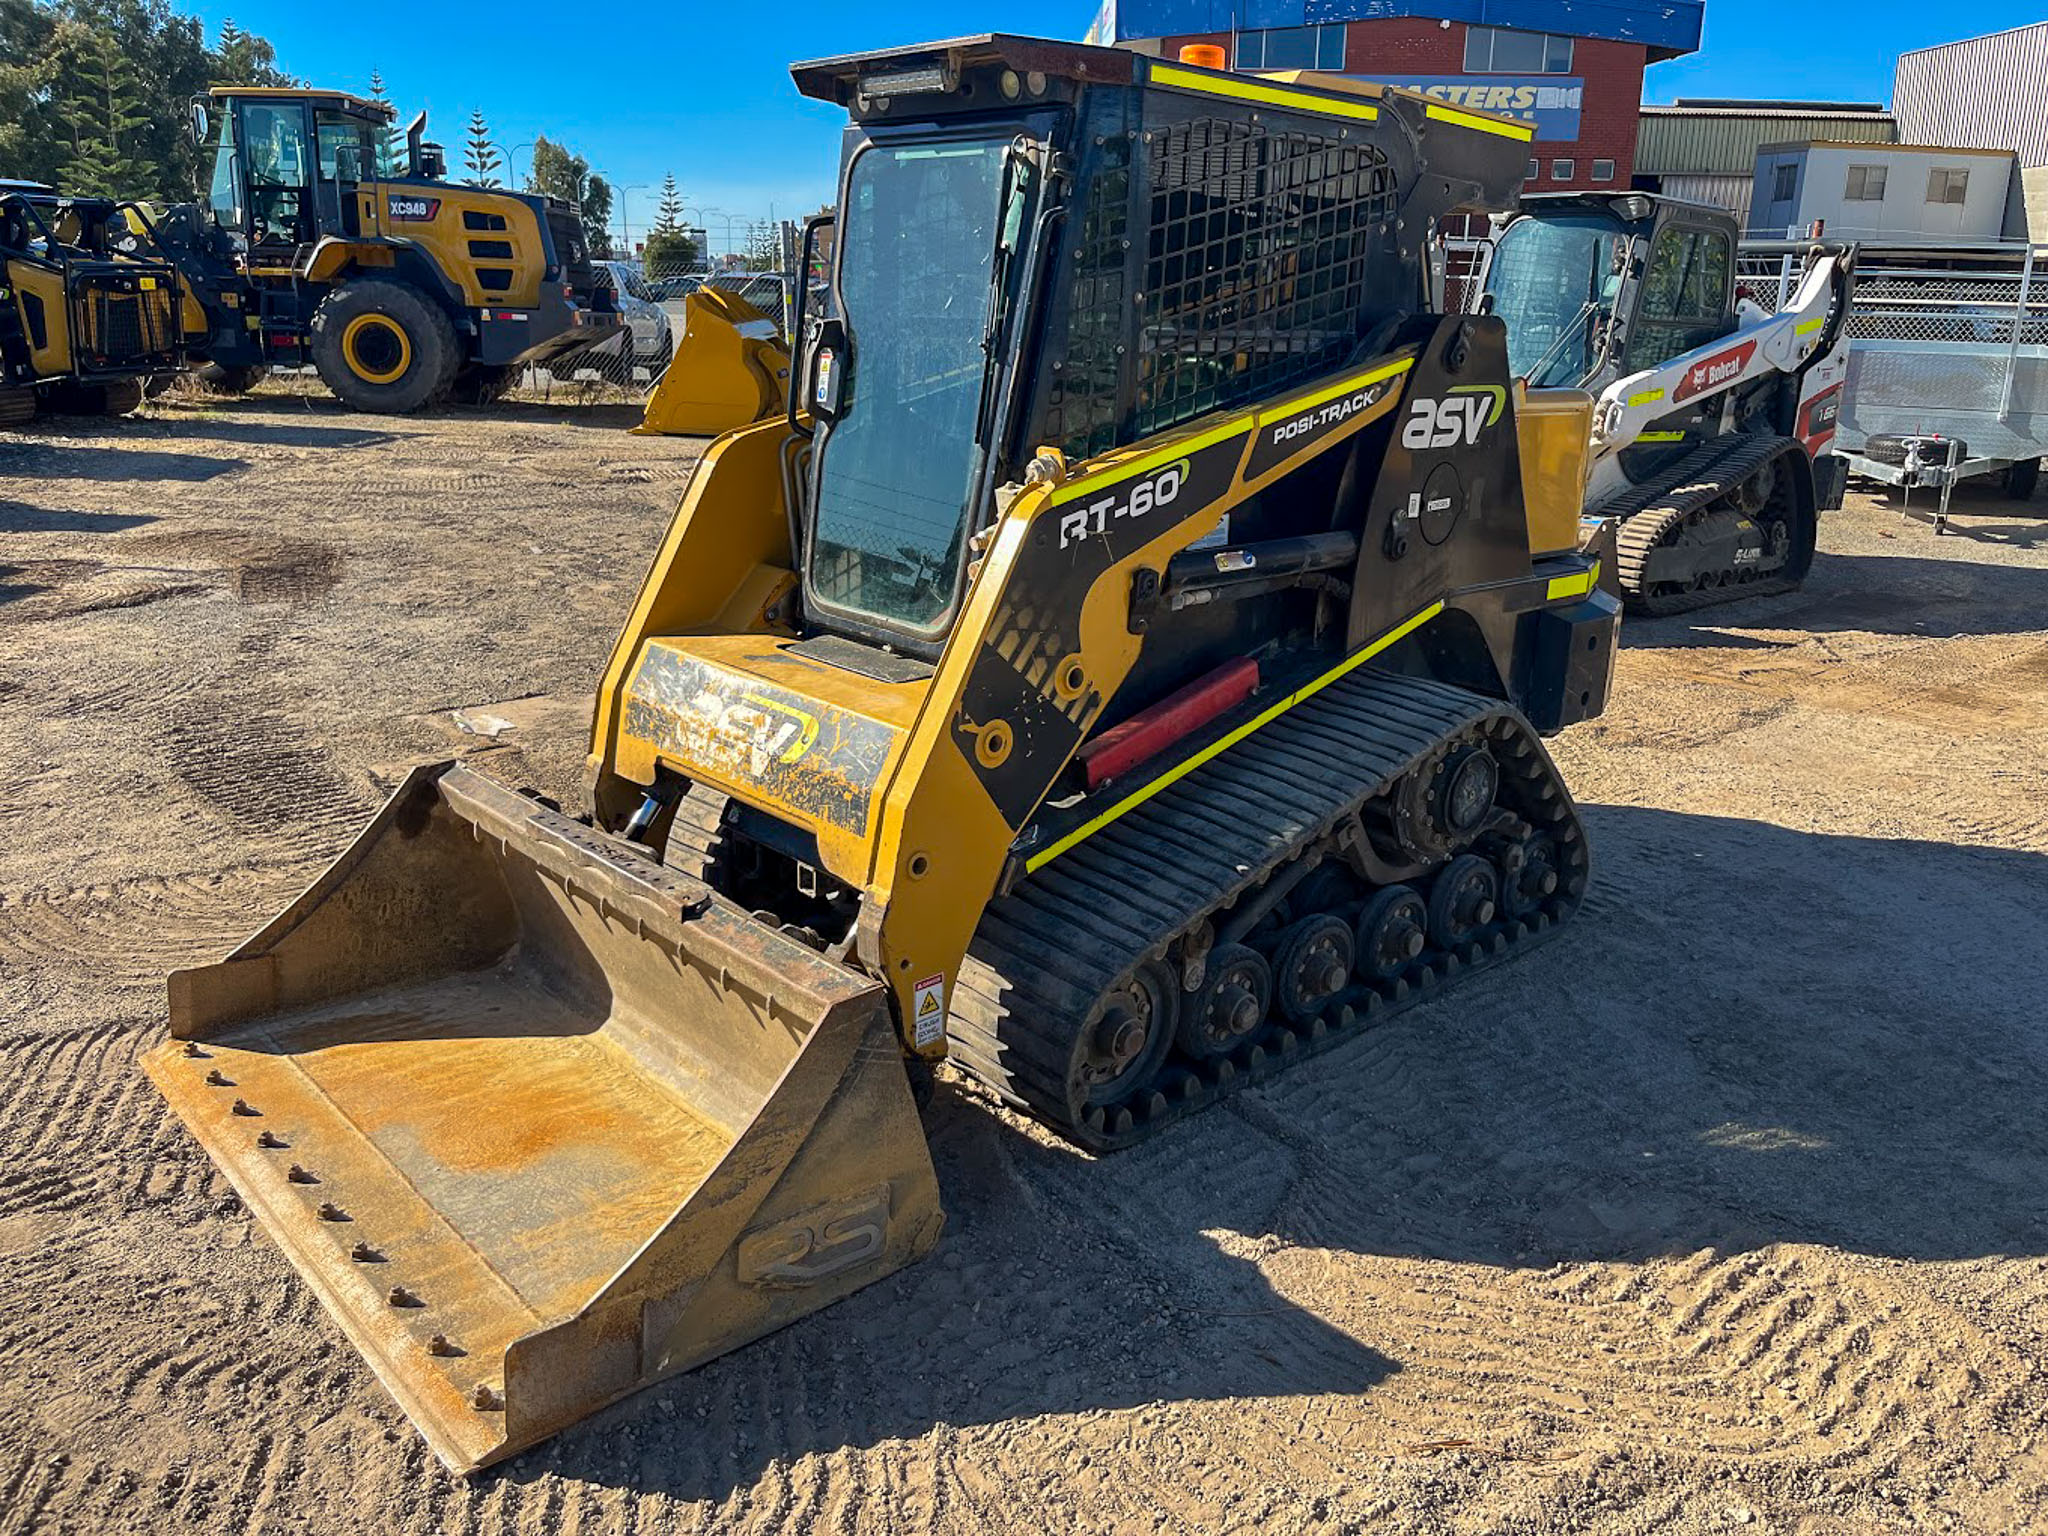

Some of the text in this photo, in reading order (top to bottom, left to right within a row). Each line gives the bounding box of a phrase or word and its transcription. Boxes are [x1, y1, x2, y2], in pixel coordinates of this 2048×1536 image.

[391, 202, 427, 215] XC948
[1709, 355, 1740, 384] Bobcat
[1273, 388, 1375, 444] POSI-TRACK
[1060, 470, 1179, 549] RT-60
